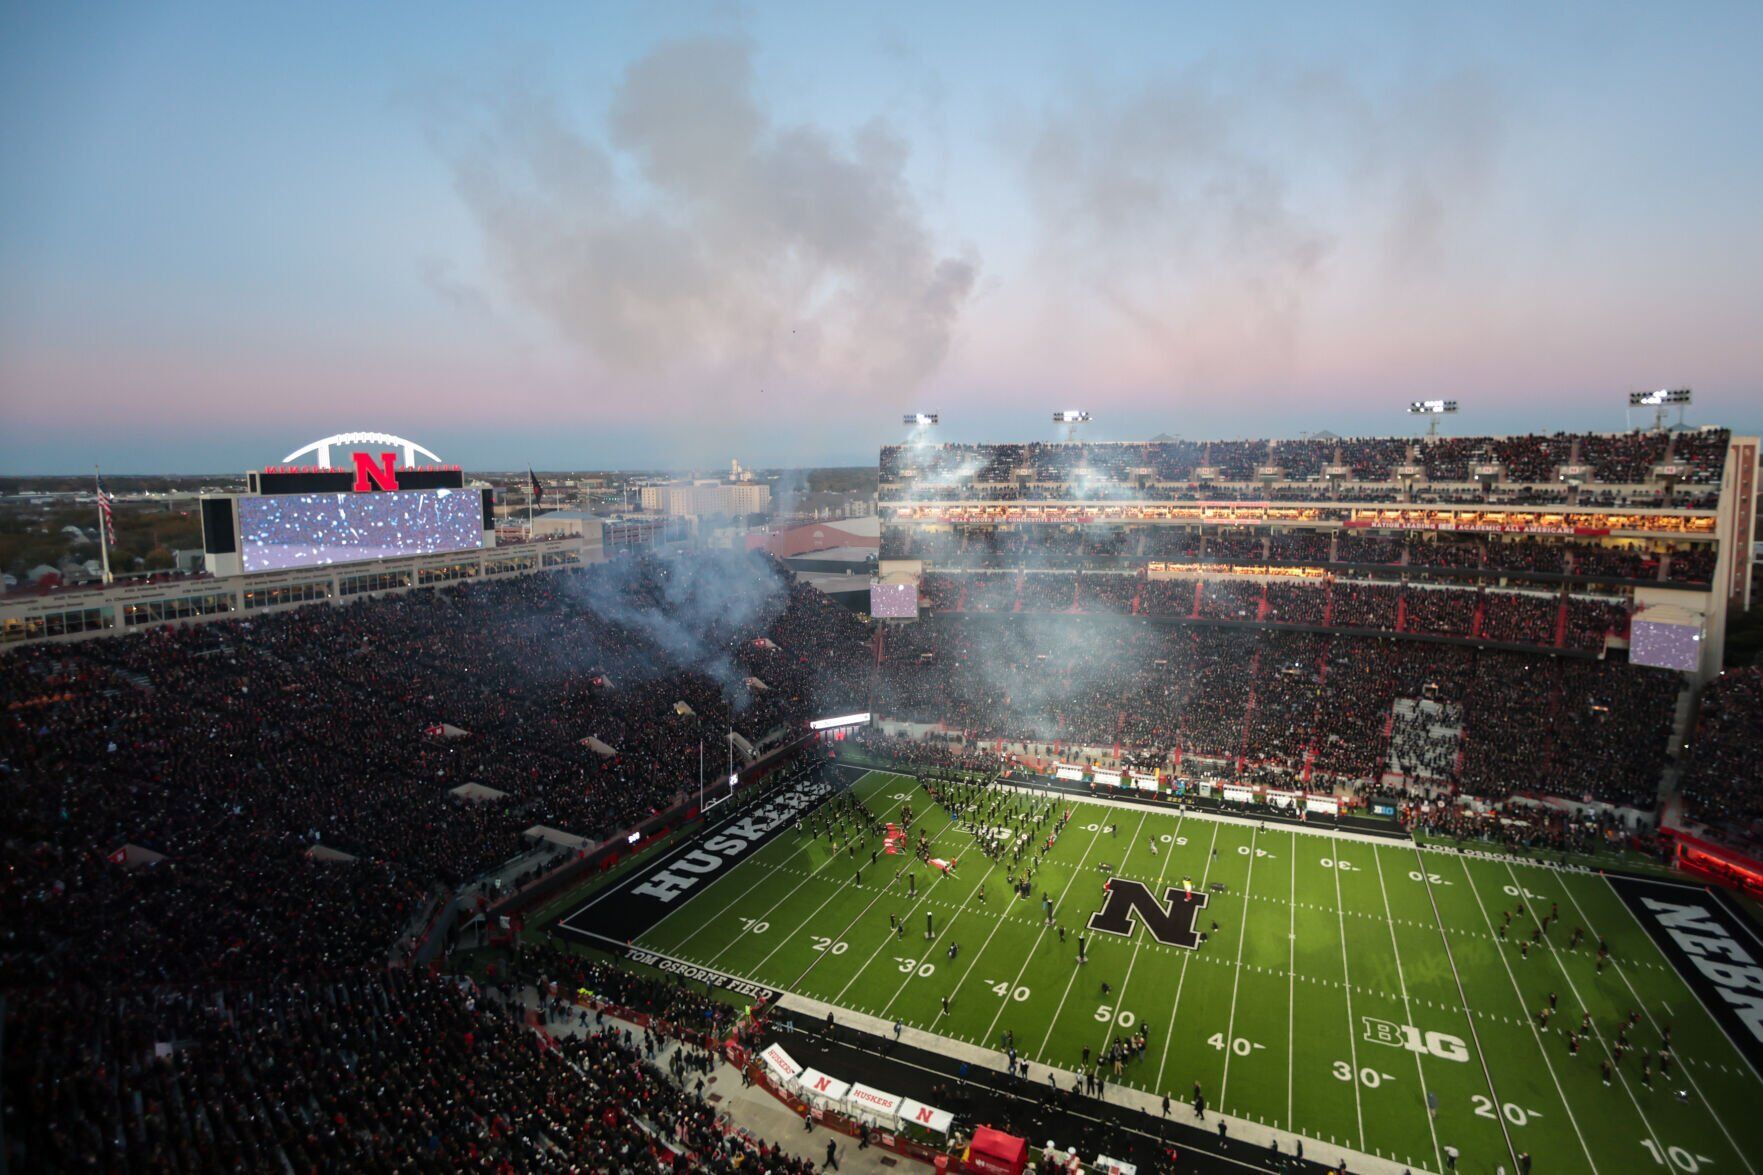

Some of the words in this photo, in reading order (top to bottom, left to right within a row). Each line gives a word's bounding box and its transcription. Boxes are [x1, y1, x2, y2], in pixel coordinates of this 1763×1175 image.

[352, 453, 398, 492] N
[1371, 520, 1400, 528] NATION
[1402, 521, 1436, 530] LEADING
[1523, 526, 1575, 534] AMERICANS
[1160, 834, 1188, 845] 50
[1423, 843, 1458, 855] TOM
[1464, 849, 1538, 865] OSBORNE
[1087, 877, 1209, 950] N
[741, 919, 770, 934] 10
[812, 937, 849, 955] 20
[624, 950, 657, 966] TOM
[659, 960, 728, 986] OSBORNE
[725, 978, 773, 1000] FIELD
[898, 958, 935, 977] 30
[992, 981, 1031, 1002] 40
[1094, 1005, 1135, 1028] 50
[1207, 1032, 1251, 1056] 40
[767, 1049, 793, 1074] HUSKERS
[813, 1076, 832, 1092] N
[1332, 1061, 1381, 1088] 30
[853, 1089, 894, 1108] HUSKERS
[915, 1107, 934, 1124] N
[1471, 1094, 1527, 1126] 20
[1640, 1138, 1699, 1173] 10
